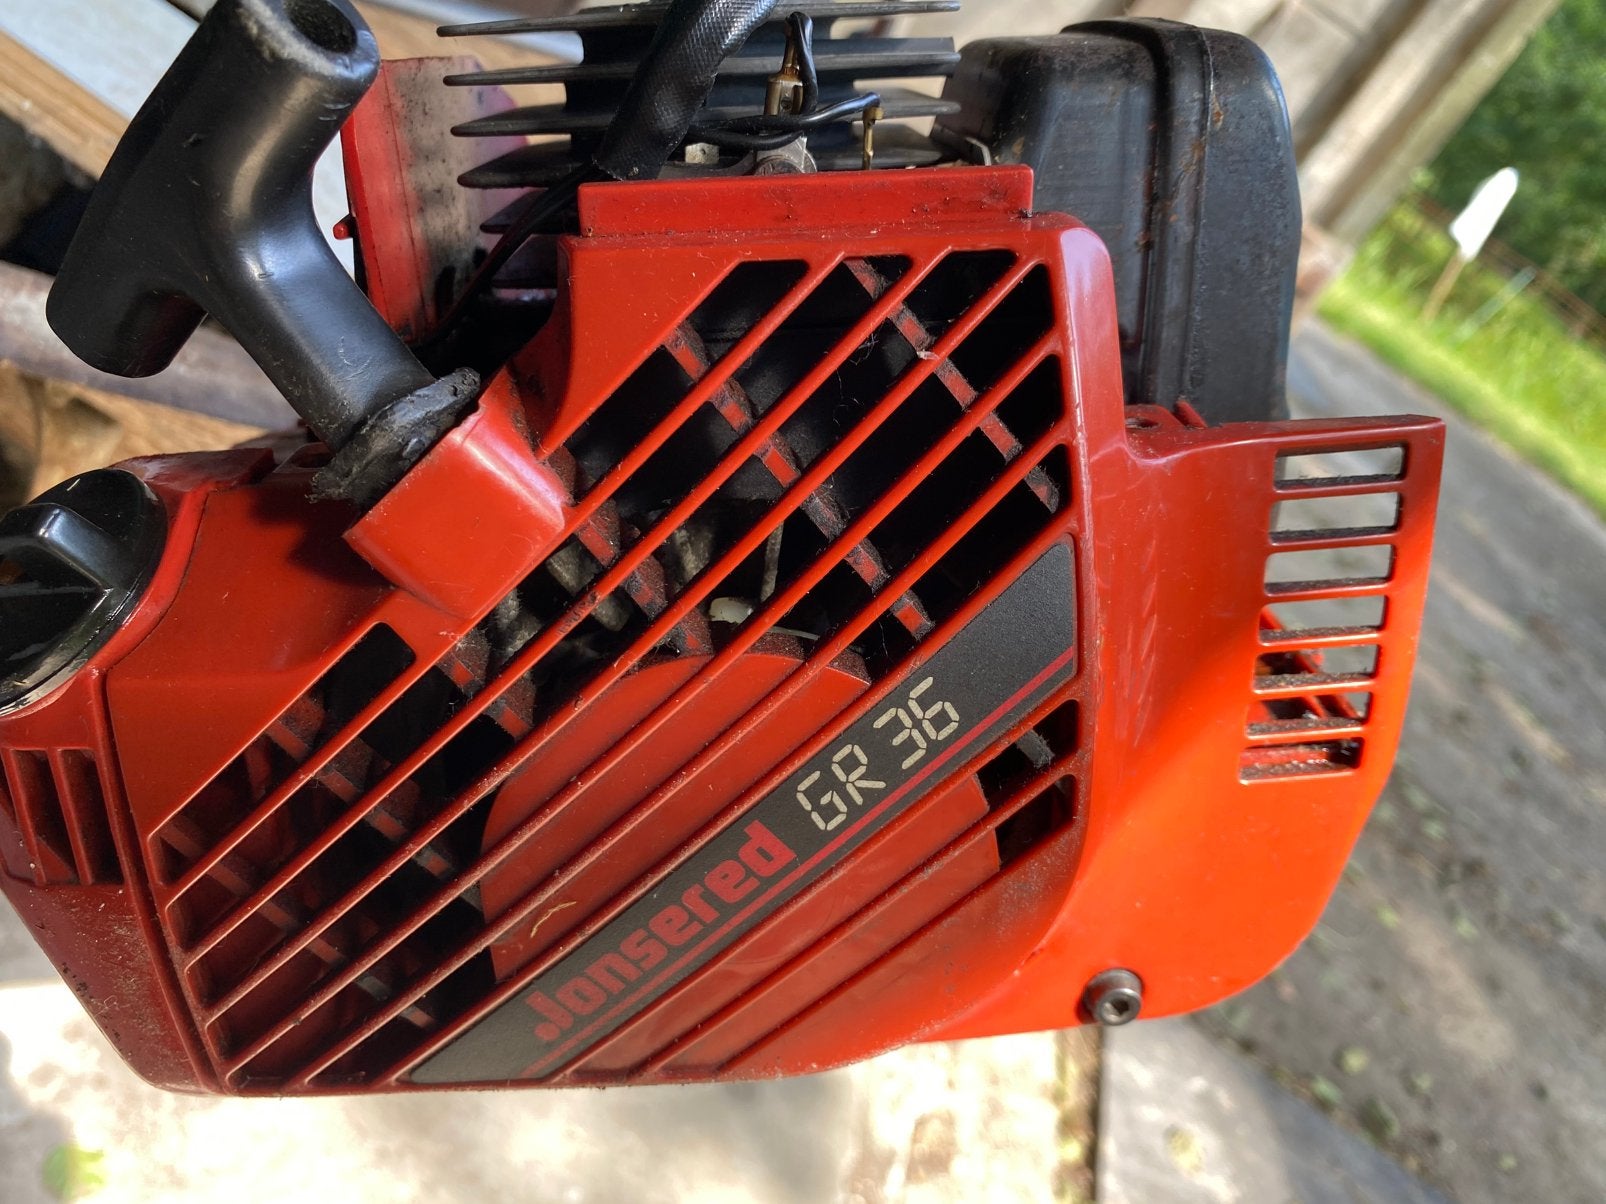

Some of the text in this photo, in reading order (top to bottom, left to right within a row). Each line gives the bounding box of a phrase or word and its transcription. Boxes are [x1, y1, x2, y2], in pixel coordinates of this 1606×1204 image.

[526, 677, 960, 1041] Jonsered GR 36
